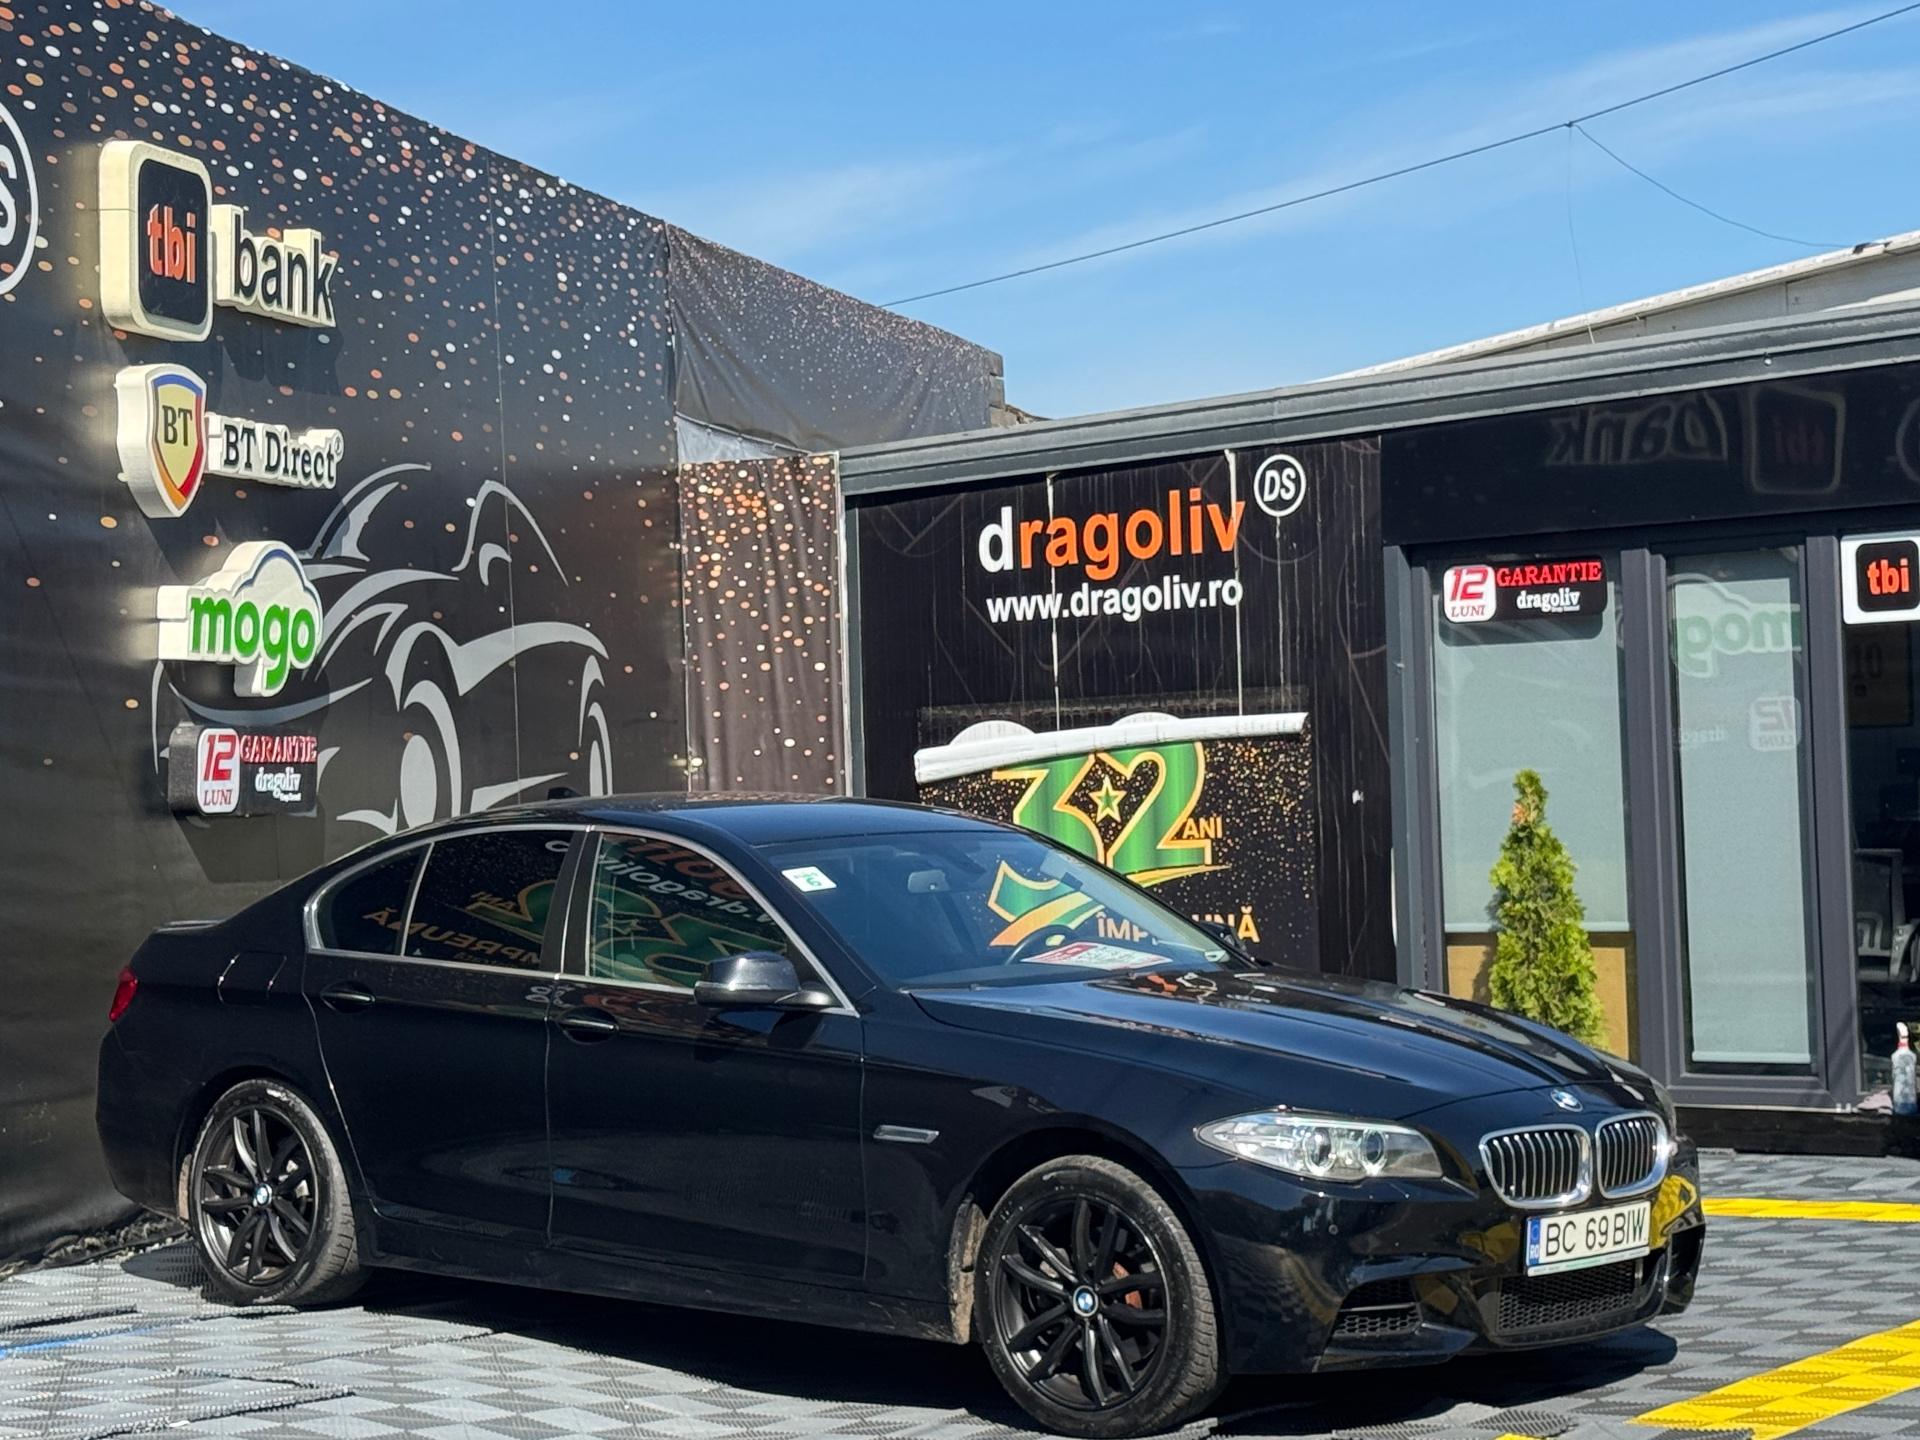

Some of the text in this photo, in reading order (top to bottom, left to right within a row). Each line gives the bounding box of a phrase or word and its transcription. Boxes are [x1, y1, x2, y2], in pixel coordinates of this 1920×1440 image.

[147, 202, 333, 320] tbi bank
[162, 404, 193, 447] BT
[223, 424, 335, 483] BT Direct
[1263, 467, 1296, 502] DS
[978, 487, 1246, 581] dragoliv
[1450, 567, 1488, 601] 12
[1496, 561, 1603, 587] GARANTIE
[1867, 558, 1910, 596] tbi
[986, 575, 1243, 623] www.dragoliv.ro
[1451, 605, 1487, 618] LUNI
[1516, 587, 1581, 612] dragoliv
[190, 596, 316, 690] mogo
[203, 734, 237, 781] 12
[240, 735, 317, 763] GARANTIE
[203, 789, 233, 806] LUNI
[255, 766, 302, 799] dragoliv
[1183, 817, 1223, 839] ANI
[1546, 1207, 1647, 1257] BC 69 BIW
